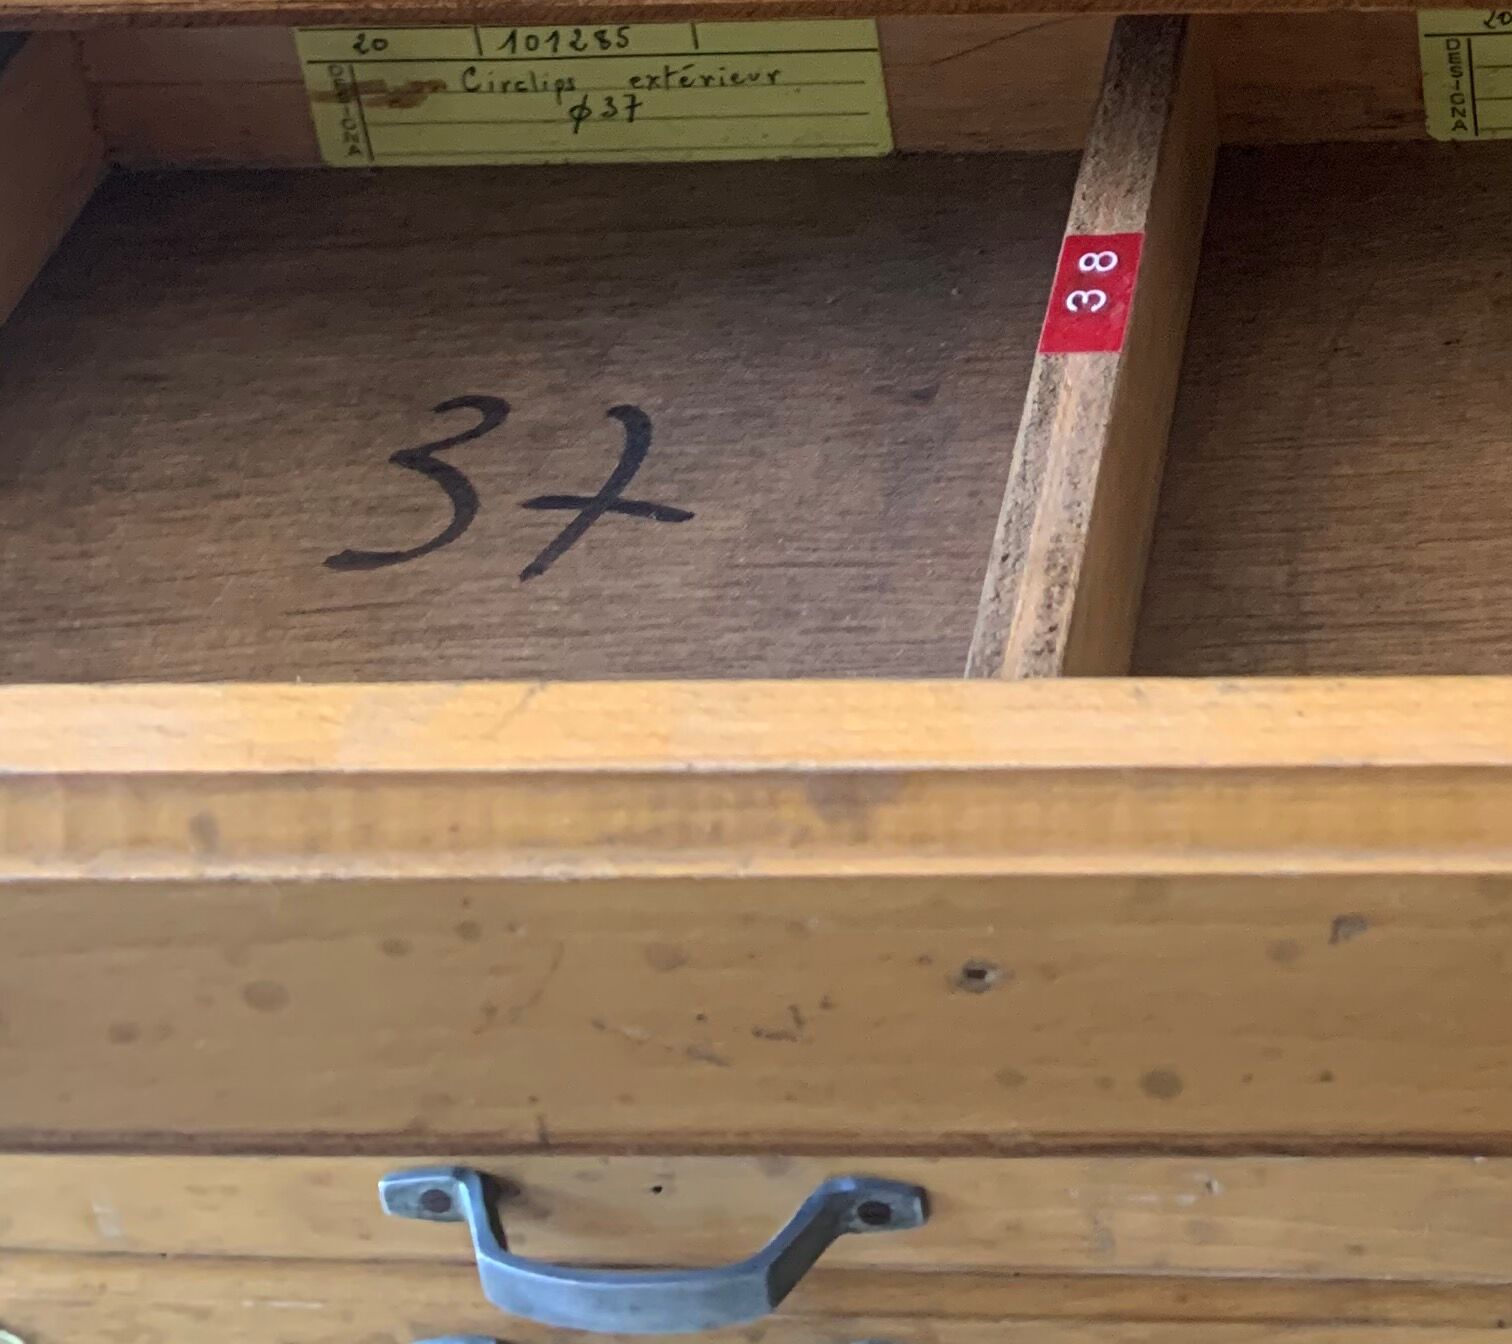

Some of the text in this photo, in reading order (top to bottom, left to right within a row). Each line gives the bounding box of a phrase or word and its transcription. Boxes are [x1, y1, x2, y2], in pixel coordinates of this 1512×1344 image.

[352, 32, 389, 56] 20
[461, 63, 782, 106] Circlips extérieur
[1066, 250, 1119, 312] 38
[321, 394, 695, 582] 37
